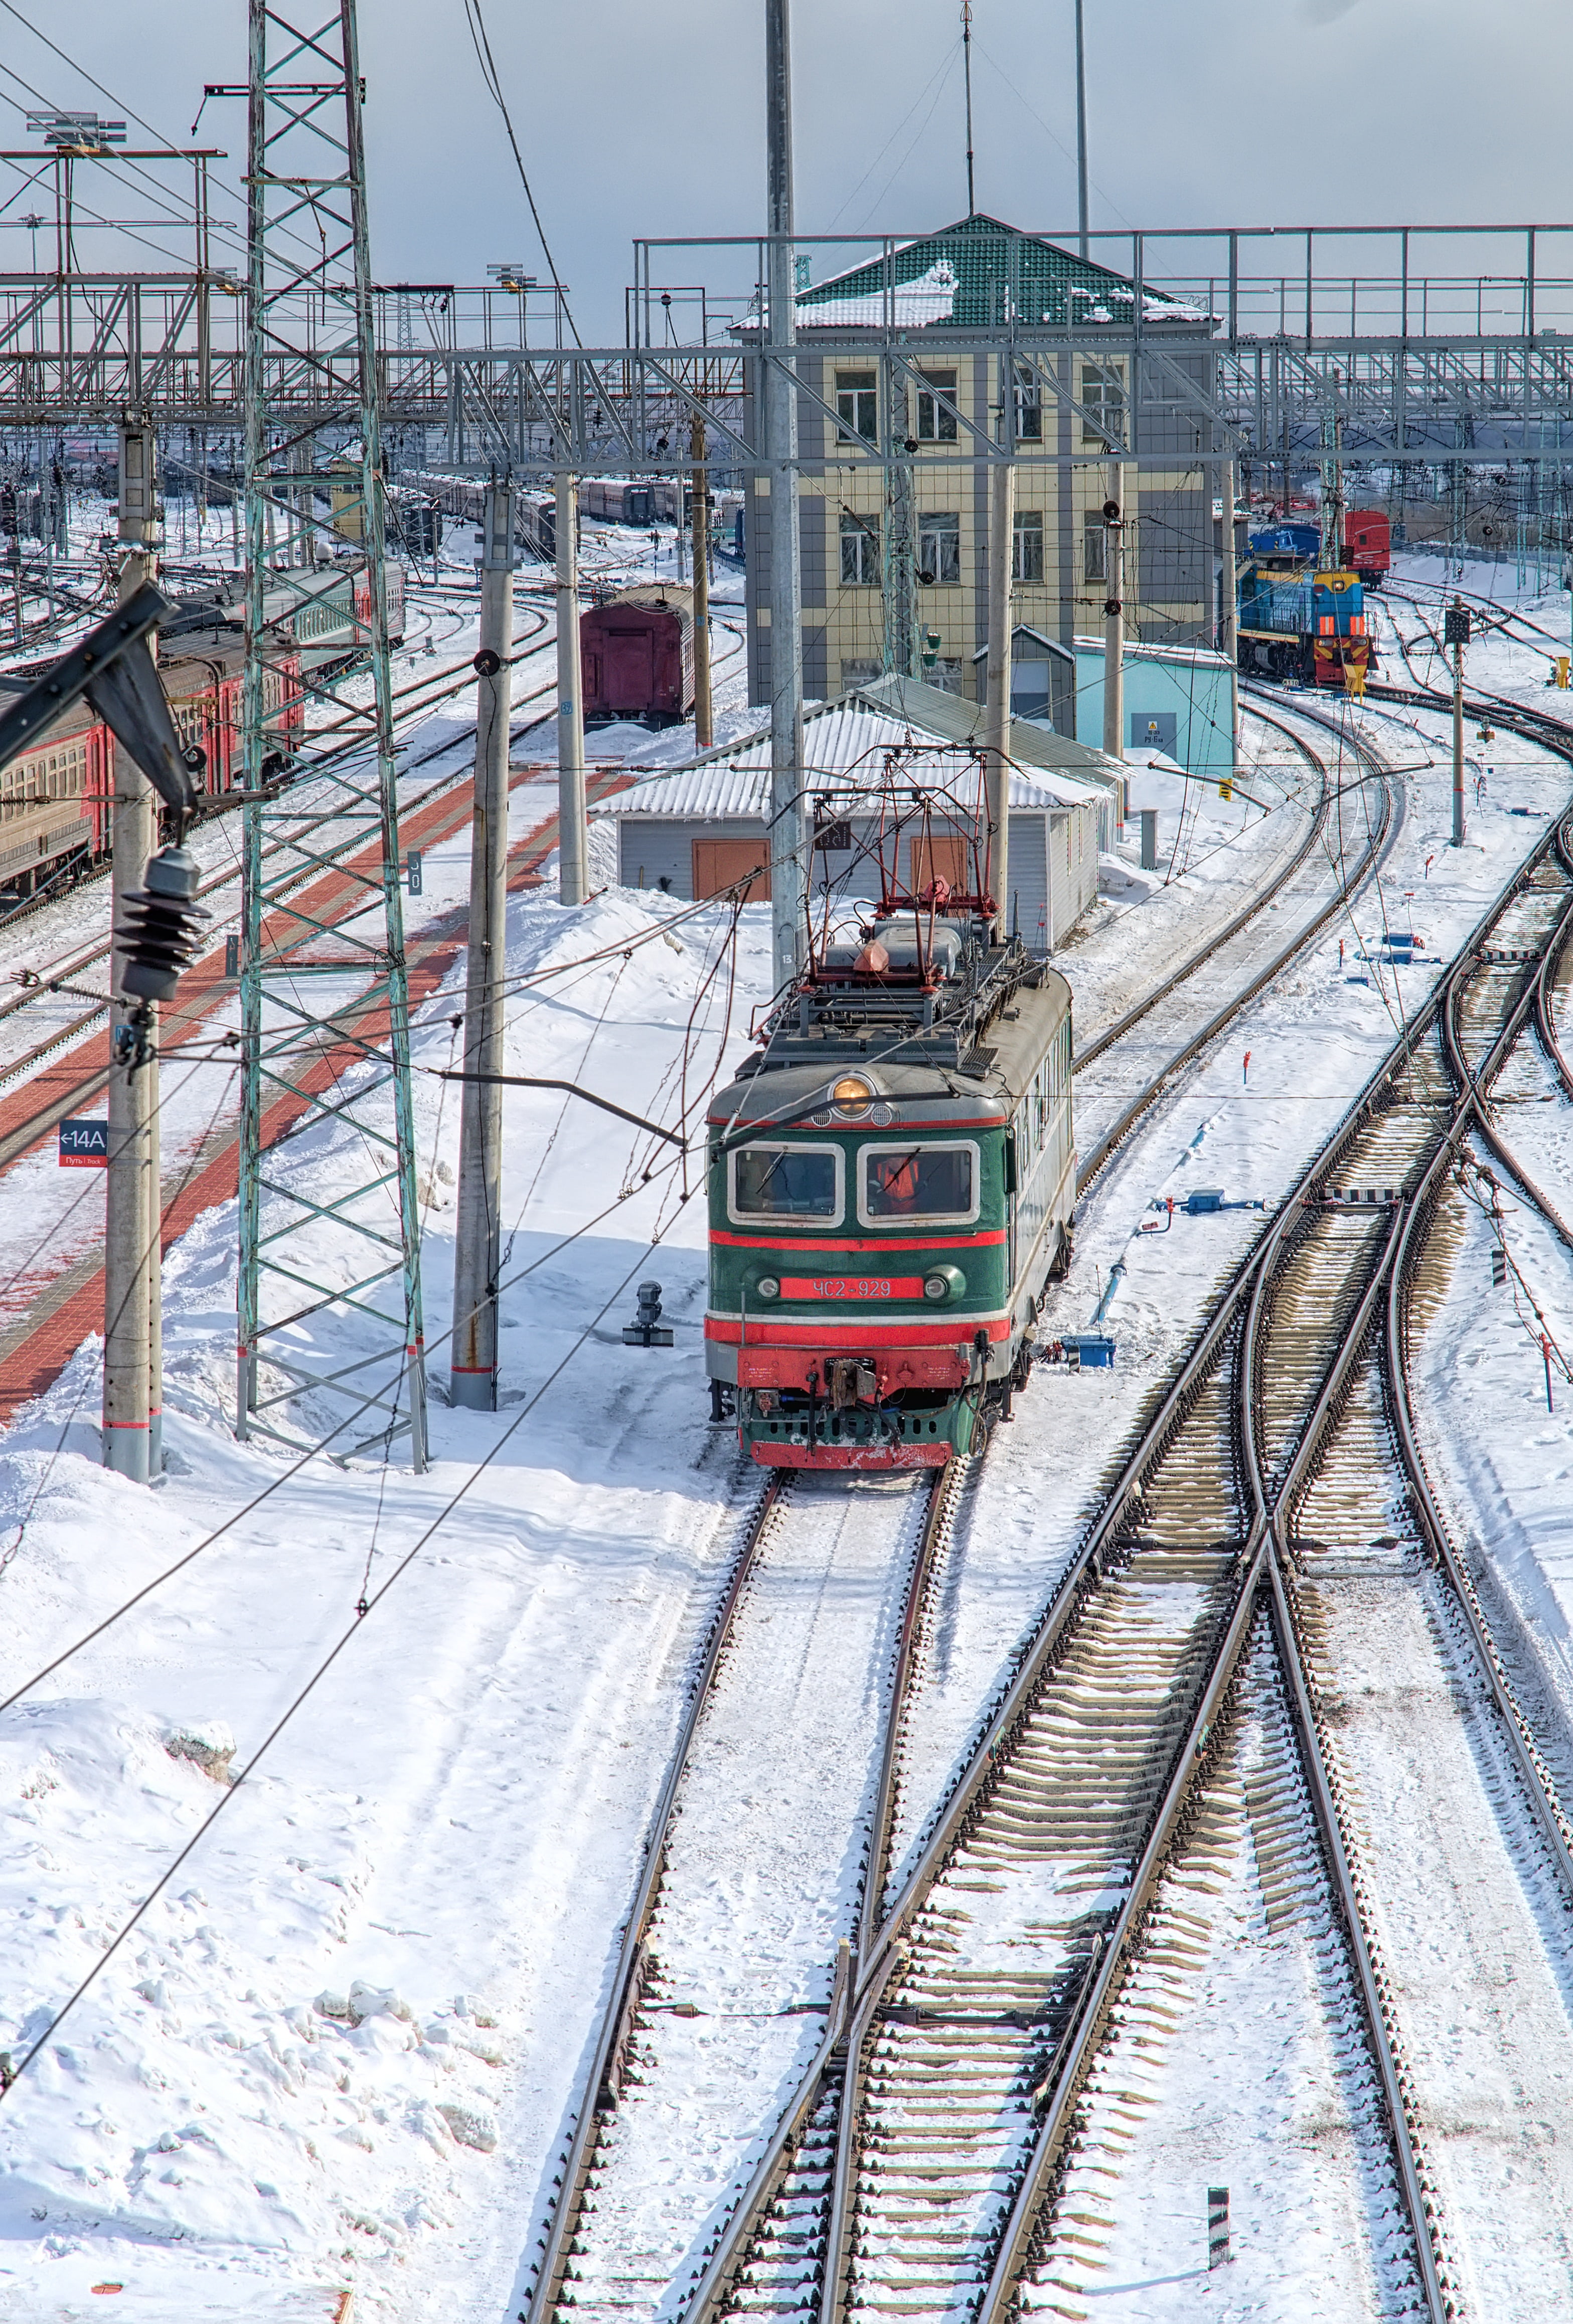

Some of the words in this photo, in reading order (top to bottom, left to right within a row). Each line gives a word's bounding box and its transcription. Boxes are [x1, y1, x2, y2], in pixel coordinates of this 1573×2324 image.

[782, 954, 792, 964] 13
[66, 1157, 83, 1165] Путь
[813, 1280, 891, 1296] ЧС2-929
